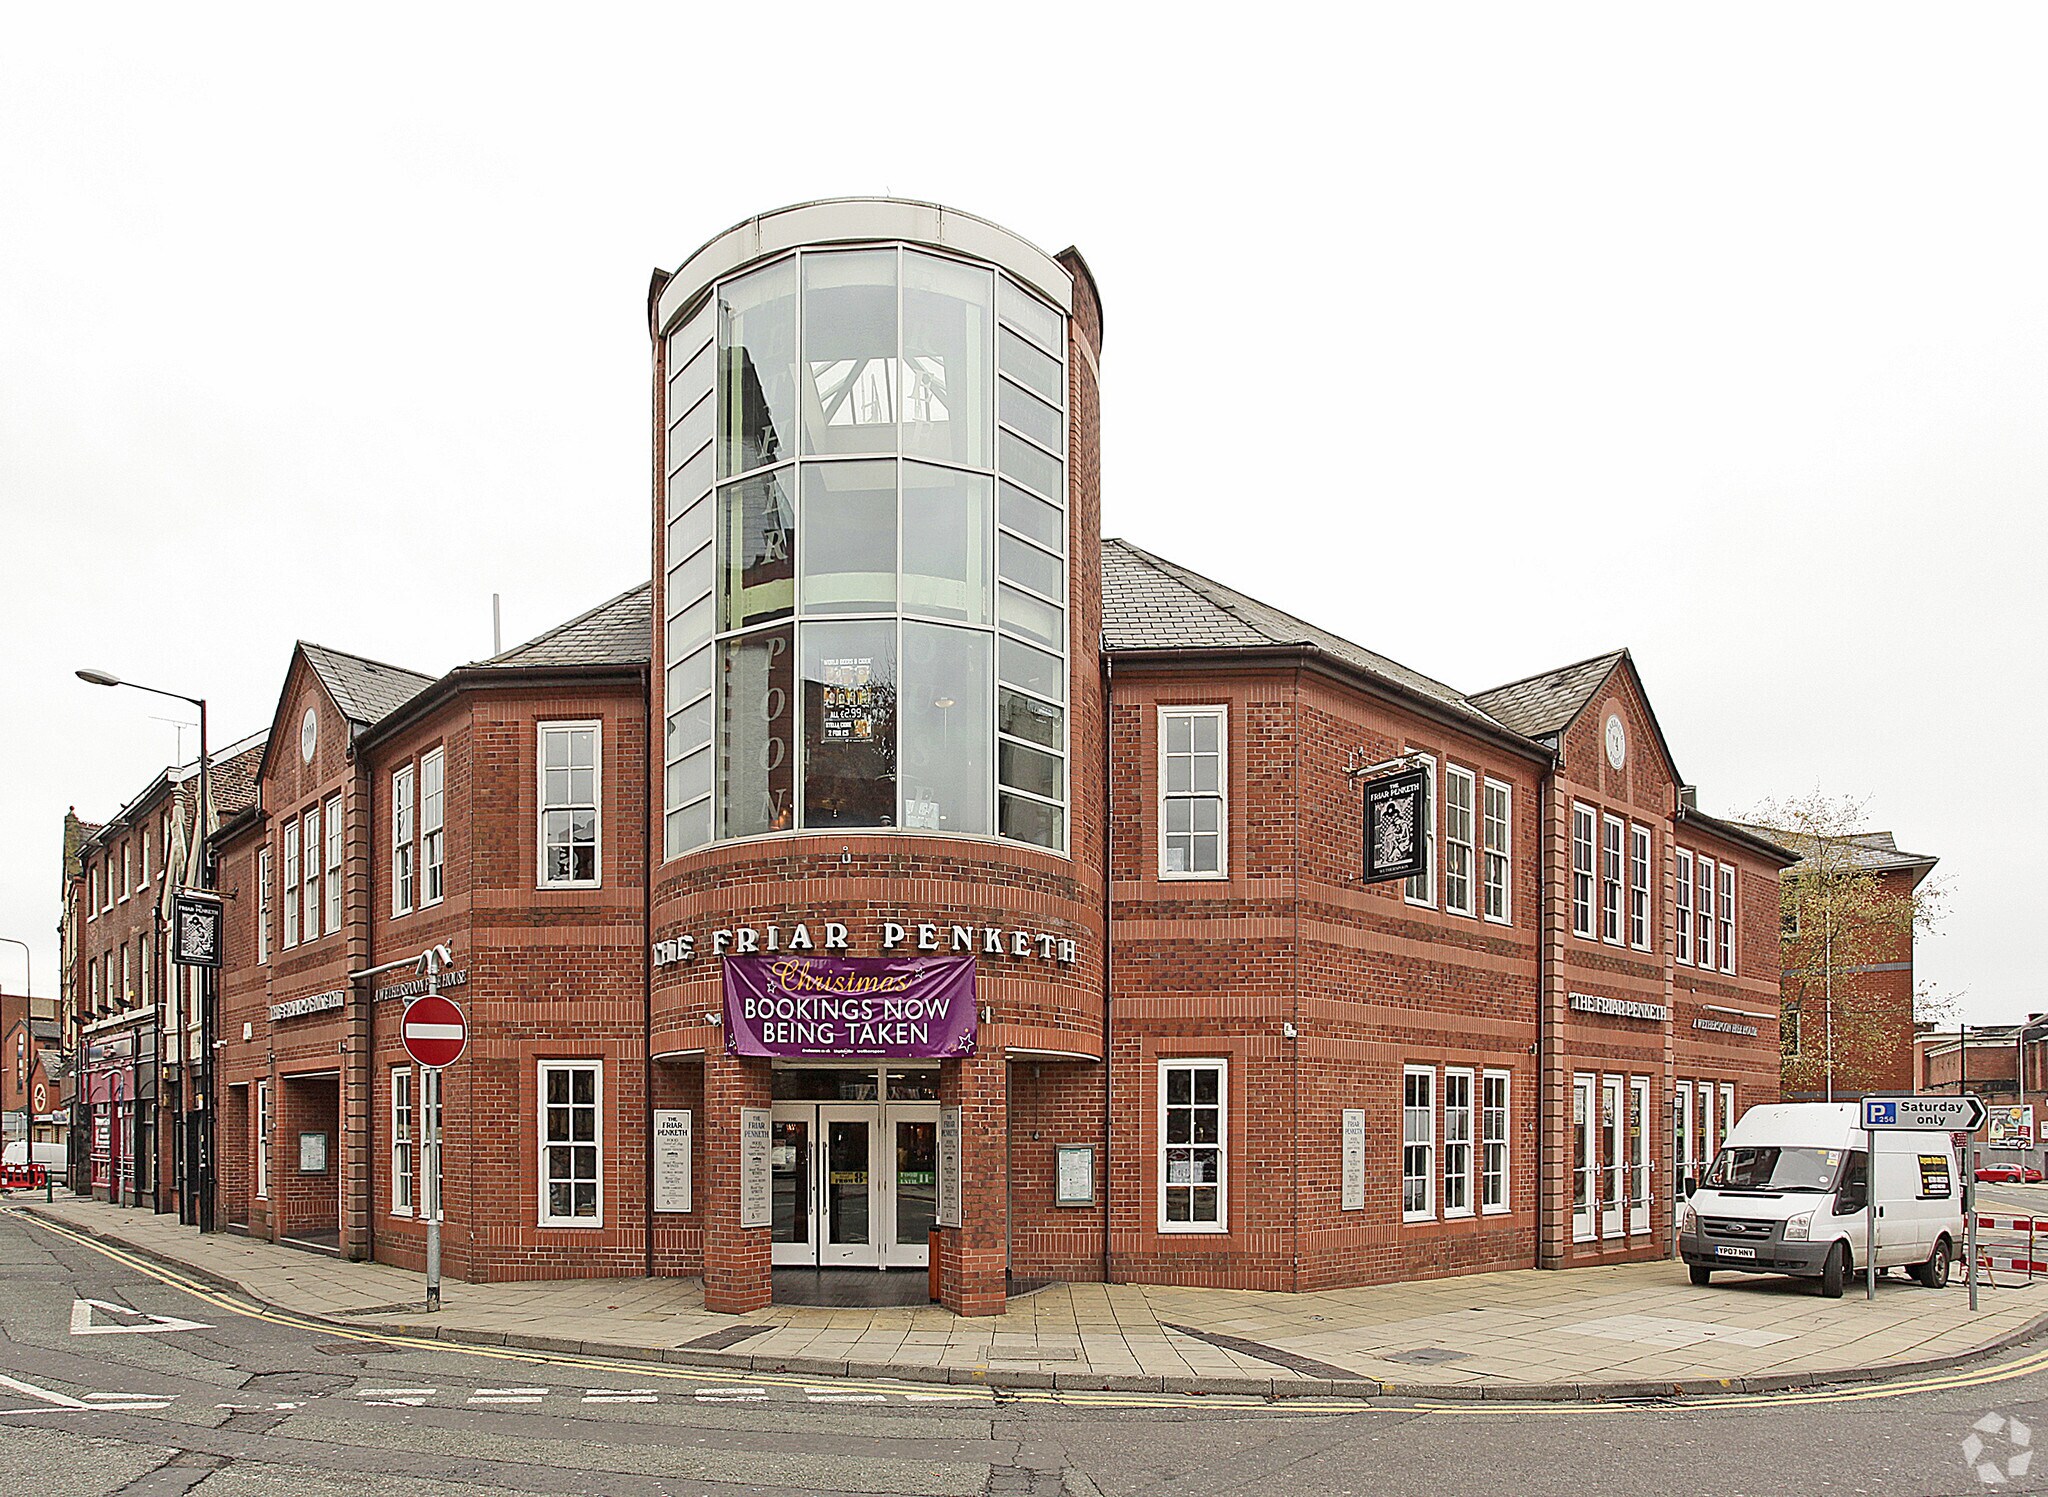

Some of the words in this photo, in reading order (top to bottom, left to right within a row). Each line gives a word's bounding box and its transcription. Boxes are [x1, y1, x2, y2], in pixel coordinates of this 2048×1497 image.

[1370, 790, 1389, 802] FRIAR
[1390, 782, 1419, 797] PENKETH
[652, 934, 696, 967] THE
[712, 922, 850, 956] FRIAR
[882, 922, 1077, 963] PENKETH
[771, 959, 913, 993] Christmas
[744, 998, 874, 1021] BOOKINGS
[883, 998, 950, 1021] NOW
[1568, 991, 1595, 1012] THE
[1595, 996, 1625, 1016] FRIAR
[1625, 1001, 1667, 1021] PENKETH
[763, 1022, 835, 1045] BEING
[844, 1022, 929, 1045] TAKEN
[1870, 1104, 1885, 1122] P
[1900, 1101, 1963, 1114] Saturday
[662, 1121, 682, 1129] FRIAR
[748, 1121, 766, 1129] FRIAR
[1917, 1114, 1946, 1126] only
[744, 1130, 769, 1138] PENKETH
